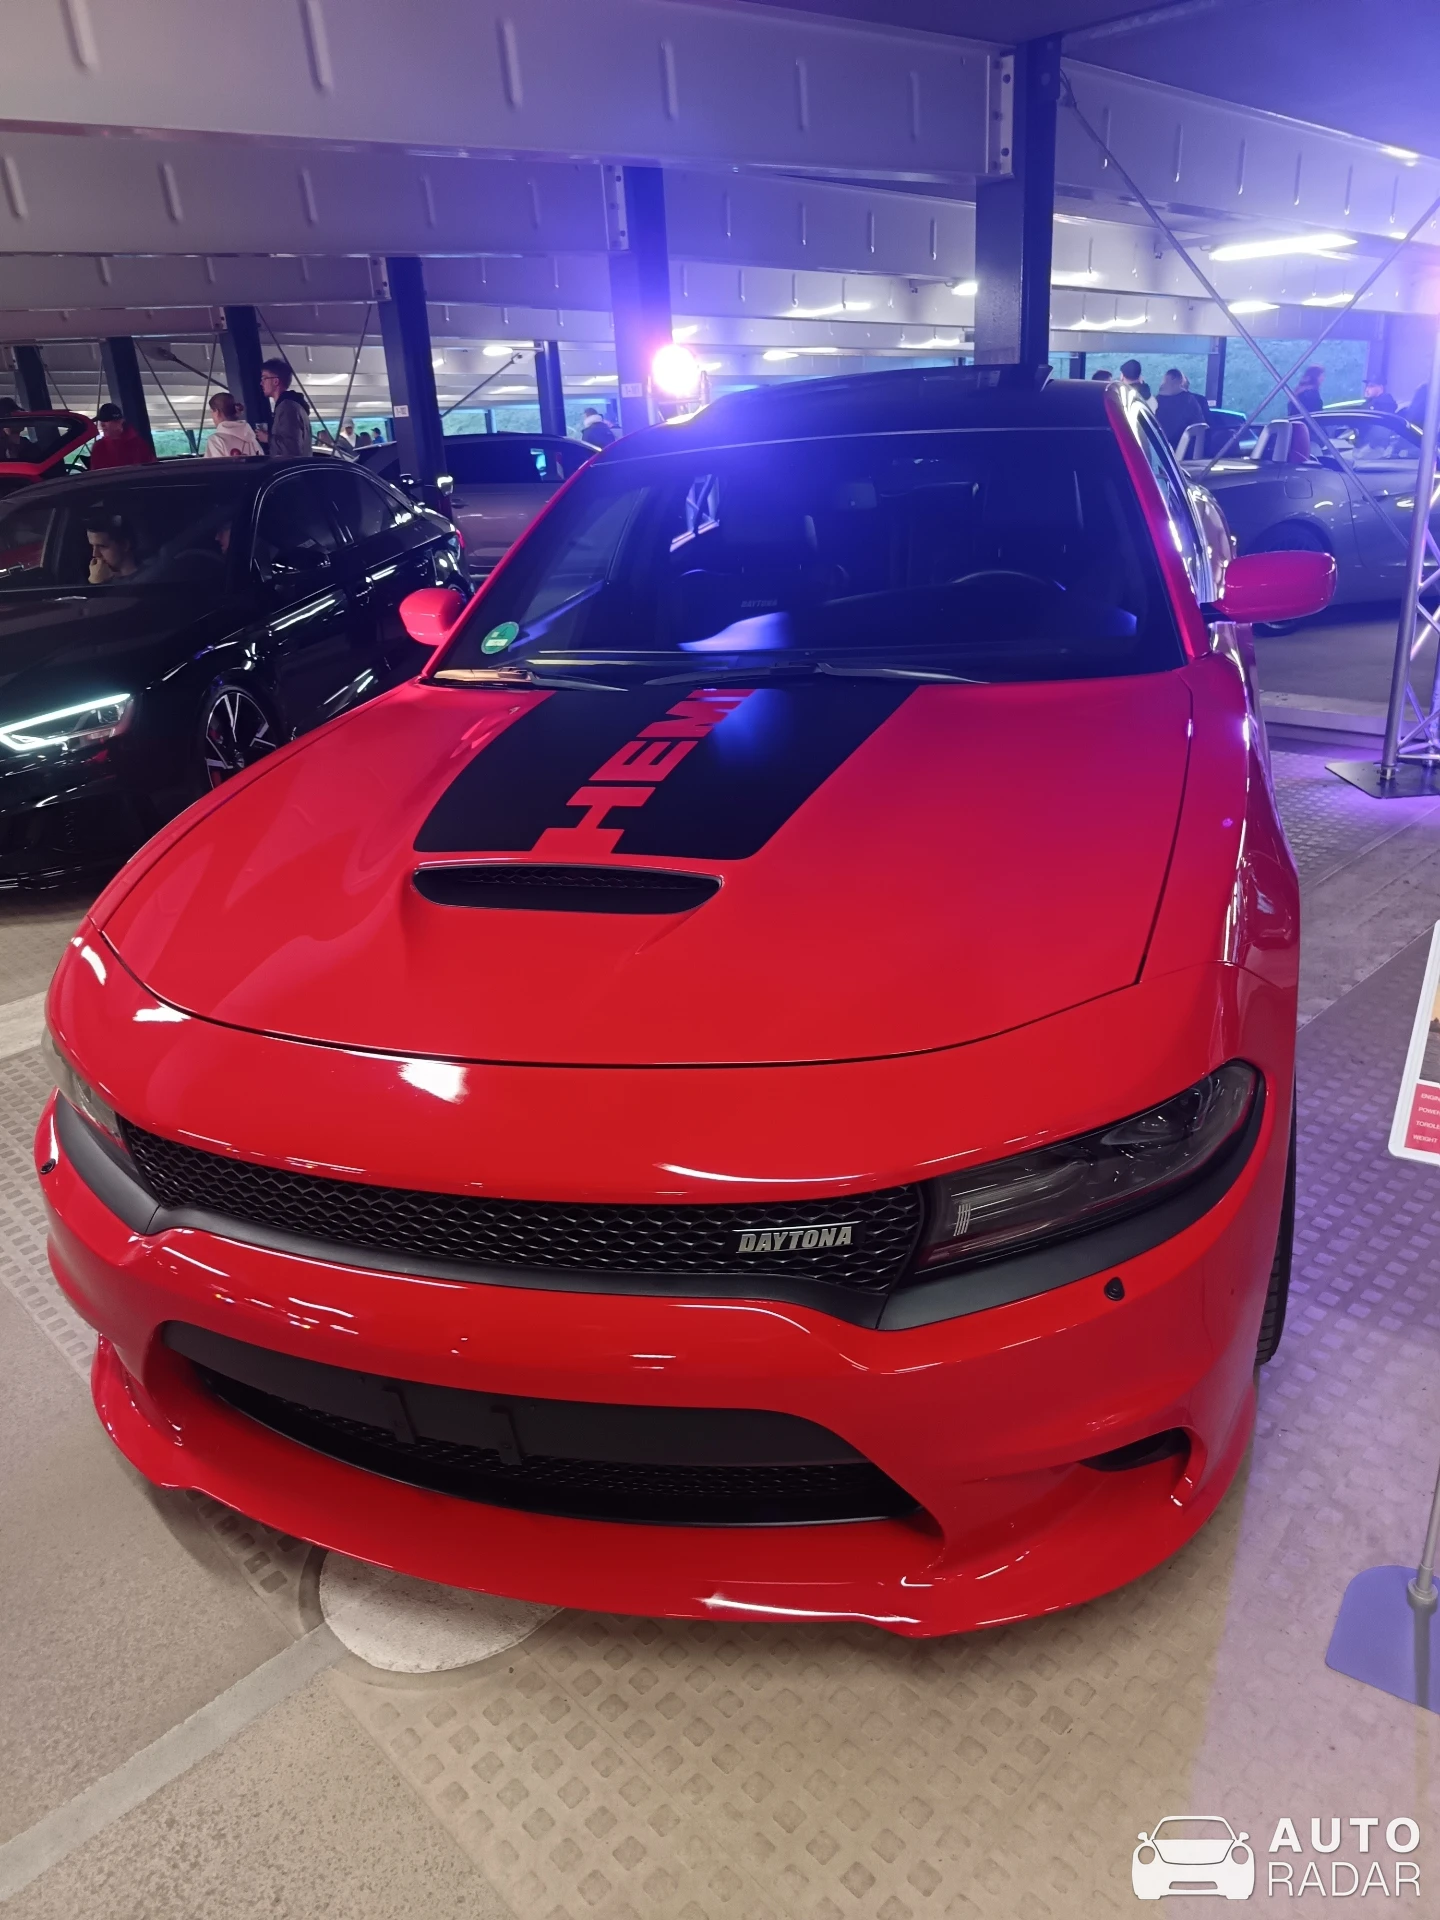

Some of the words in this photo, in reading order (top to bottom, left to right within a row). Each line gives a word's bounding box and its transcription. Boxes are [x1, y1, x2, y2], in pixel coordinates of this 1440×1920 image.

[531, 689, 757, 854] HEMI
[1420, 1092, 1440, 1102] ENGIN
[1412, 1134, 1438, 1144] WEIGHT
[738, 1226, 852, 1252] DAYTONA
